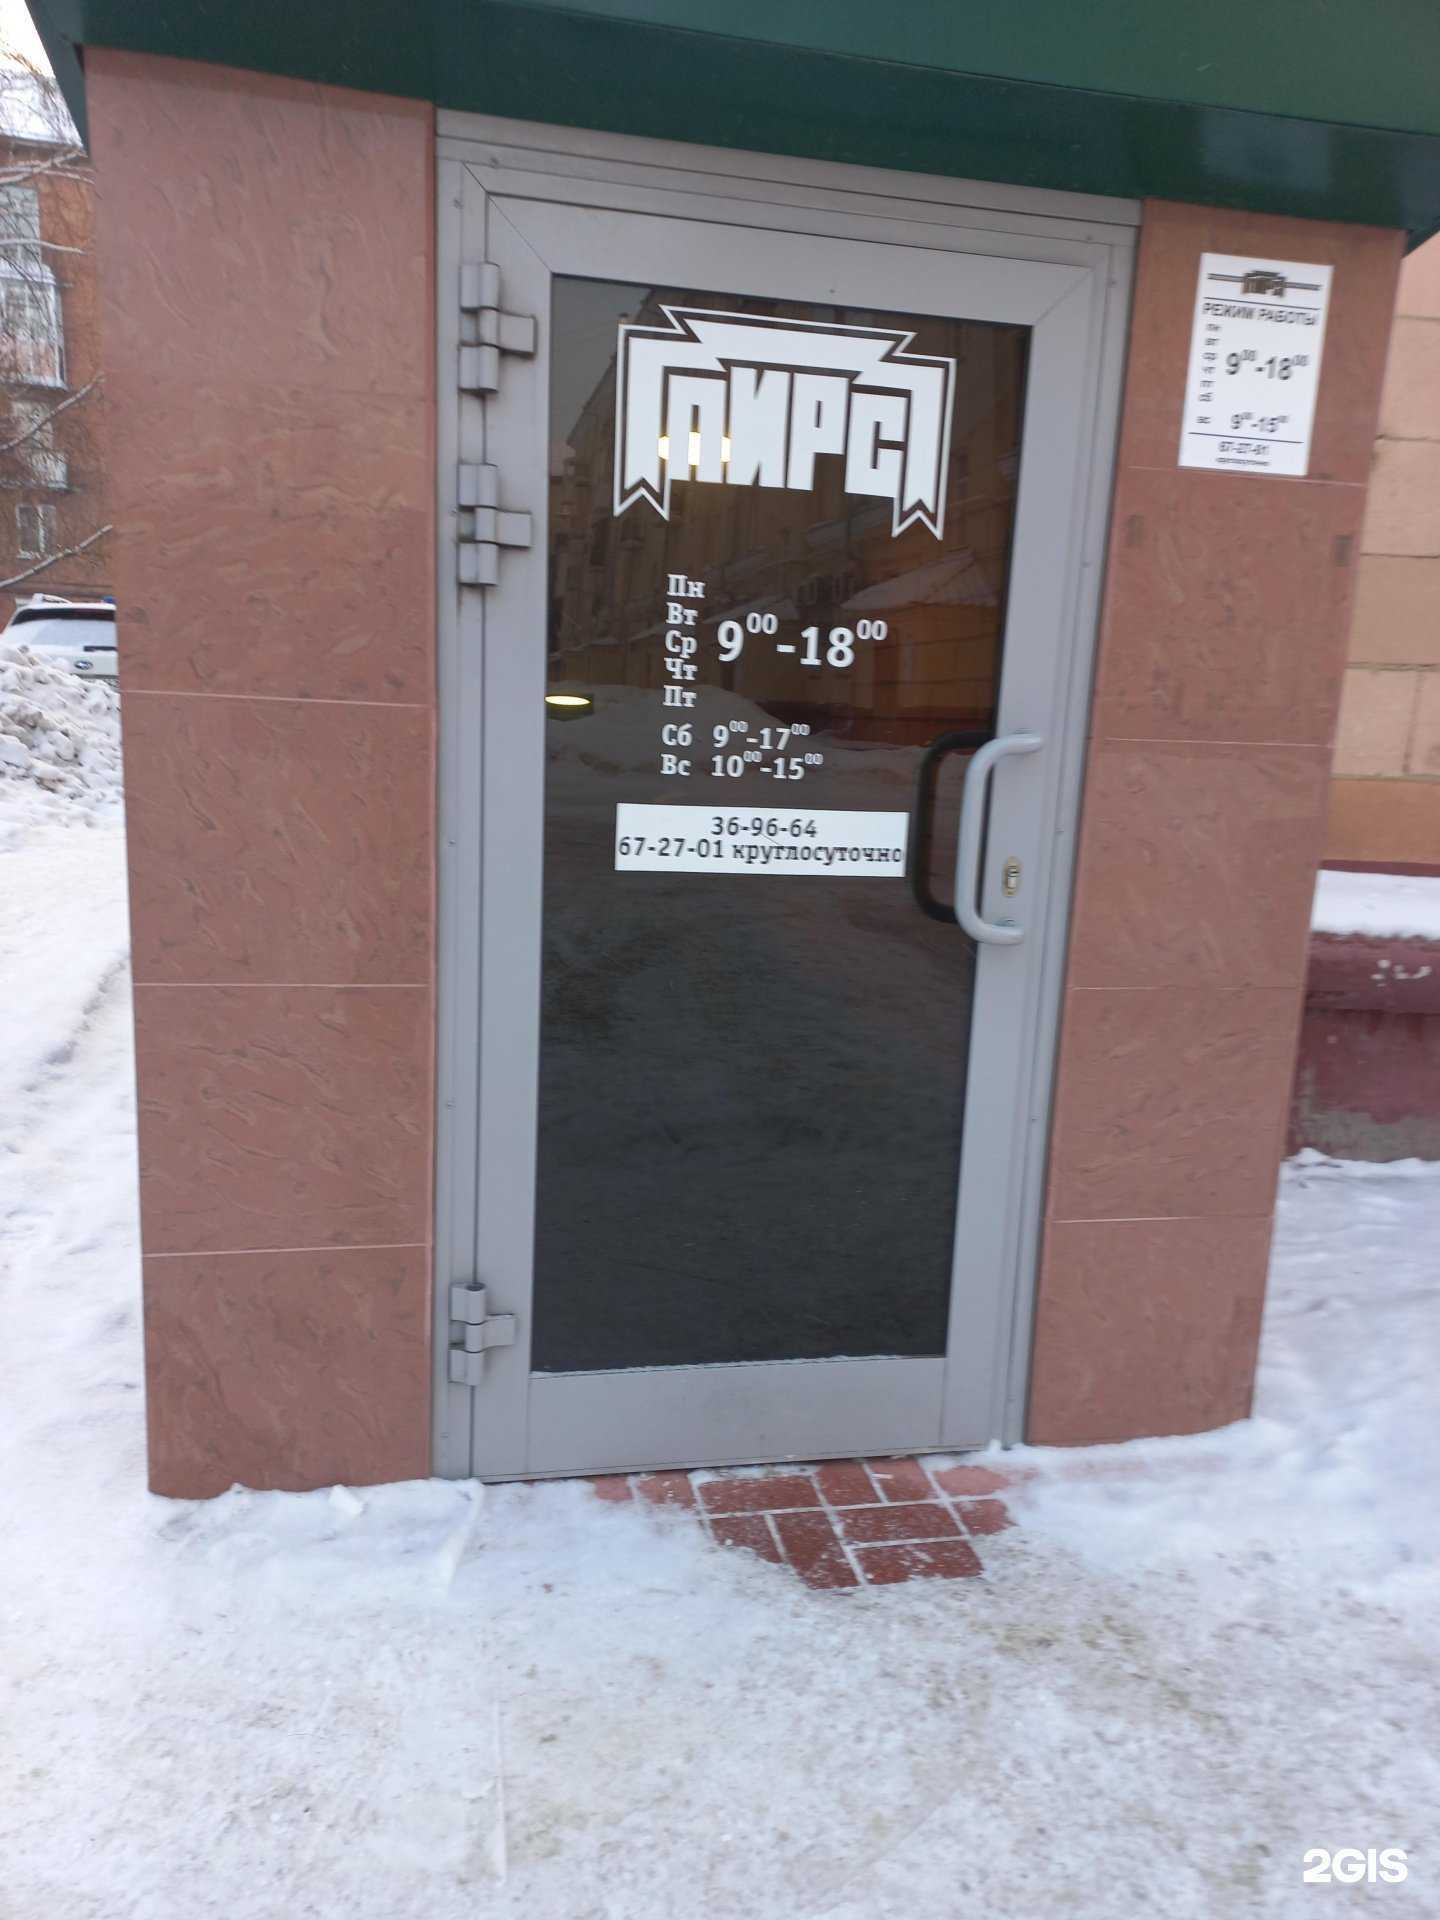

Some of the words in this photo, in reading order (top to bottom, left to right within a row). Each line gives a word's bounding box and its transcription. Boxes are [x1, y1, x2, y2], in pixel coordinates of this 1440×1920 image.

[1202, 302, 1256, 319] РЕЖИМ
[1257, 308, 1317, 326] РАБОТЫ
[666, 366, 908, 499] ПИРС
[666, 574, 705, 599] Пн
[665, 603, 698, 626] Вт
[665, 631, 697, 658] Ср
[664, 658, 698, 681] Чт
[663, 685, 696, 708] Пт
[662, 724, 693, 747] Сб
[661, 754, 691, 776] Вс
[711, 817, 818, 838] 36-96-64
[619, 838, 723, 858] 67-27-01
[732, 843, 903, 866] круглосуточно
